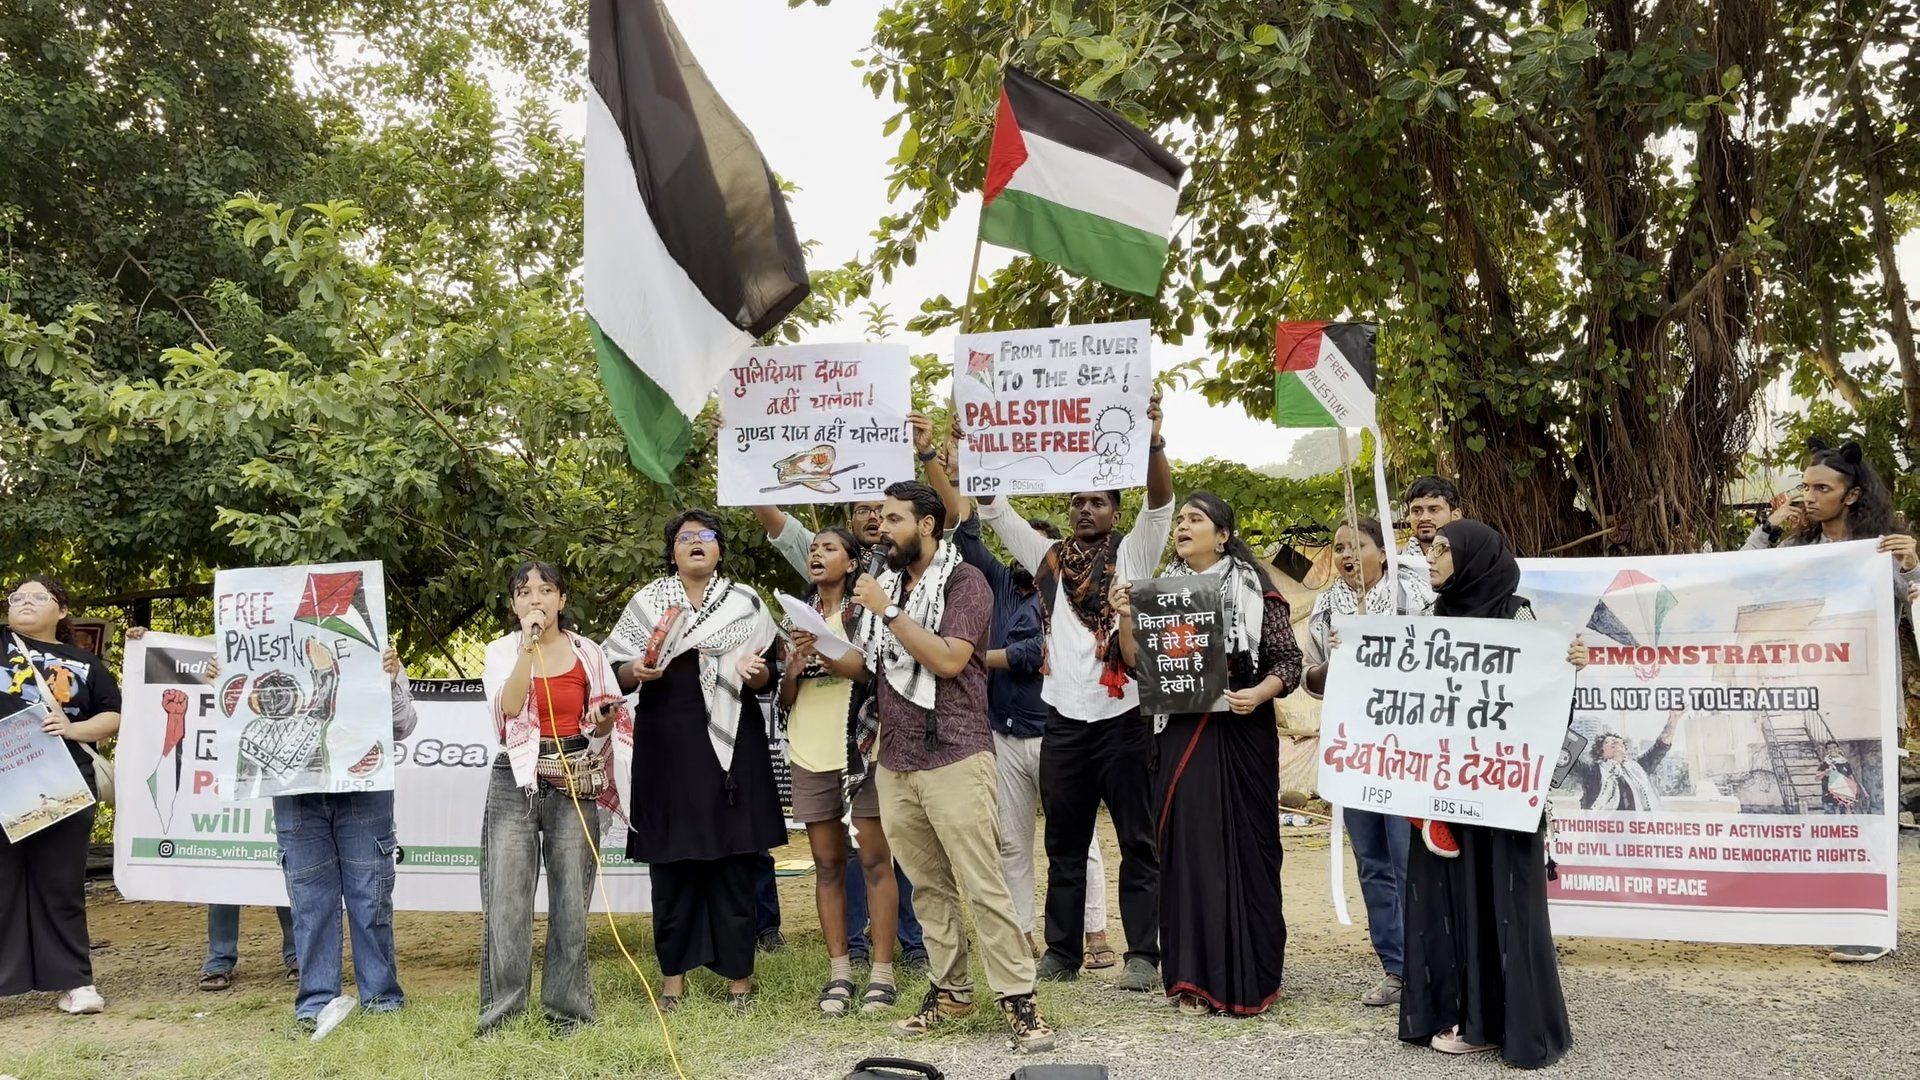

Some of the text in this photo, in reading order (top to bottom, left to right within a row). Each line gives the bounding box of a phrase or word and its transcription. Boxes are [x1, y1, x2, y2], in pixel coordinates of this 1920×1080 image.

[1000, 335, 1138, 362] FROM THE RIVER
[815, 359, 862, 383] दमन
[1324, 352, 1349, 382] FREE
[999, 370, 1023, 392] TO
[1032, 368, 1068, 388] THE
[766, 388, 800, 415] नहीं
[1305, 370, 1349, 420] PALESTINE
[965, 397, 1091, 427] PALESTINE
[781, 424, 810, 442] राज
[814, 417, 846, 444] नहीं
[967, 433, 1009, 453] WILL
[1012, 432, 1037, 452] BE
[853, 477, 886, 490] IPSP
[966, 476, 1000, 492] IPSP
[1157, 587, 1192, 607] दम है
[218, 591, 275, 630] FREE
[1138, 611, 1215, 630] कितना दमन
[225, 623, 351, 671] PALESTINE
[1147, 631, 1209, 651] में तेरे देख
[1355, 624, 1521, 674] दम है कितना
[1157, 652, 1204, 672] लिया है
[1588, 642, 1850, 665] EMONSTRATION
[175, 659, 208, 675] Indi
[440, 681, 484, 693] Pales
[1160, 674, 1195, 694] देखेंगे
[1366, 676, 1514, 730] दमन में तेरे
[1574, 687, 1818, 711] ILL NOT BE TOLERATED!
[1324, 722, 1376, 775] देख
[1377, 733, 1433, 782] लिया
[1433, 738, 1450, 791] है
[335, 779, 375, 792] IPSP
[1362, 786, 1393, 804] IPSP
[1433, 799, 1481, 818] BDS India
[191, 807, 276, 834] will b
[1629, 821, 1700, 836] SEARCHES
[1706, 823, 1723, 837] OF
[1811, 825, 1859, 838] HOMES
[175, 844, 278, 860] indians_with_pale
[411, 851, 477, 866] indianpsp,
[1555, 842, 1573, 855] ON
[1577, 842, 1611, 856] CIVIL
[1616, 844, 1684, 859] LIBERTIES
[1688, 847, 1717, 860] AND
[1722, 847, 1812, 862] DEMOCRATIC
[1817, 849, 1871, 862] RIGHTS.
[1561, 874, 1708, 896] MUMBAI FOR PEACE
